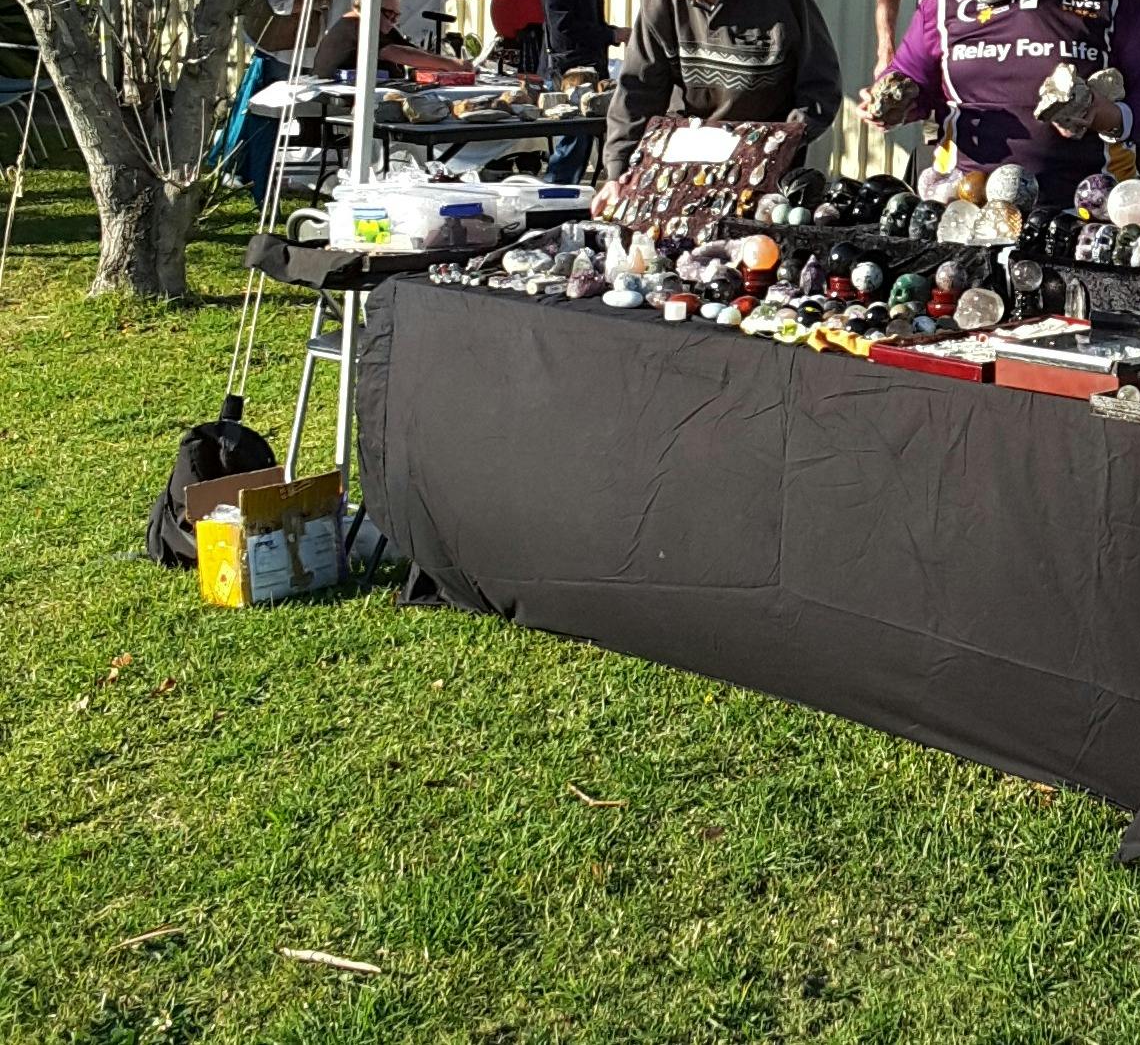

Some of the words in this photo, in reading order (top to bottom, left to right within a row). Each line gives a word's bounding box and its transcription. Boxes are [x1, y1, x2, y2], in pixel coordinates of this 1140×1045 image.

[952, 41, 1011, 61] Relay
[1016, 38, 1054, 57] For
[1060, 41, 1099, 61] Life
